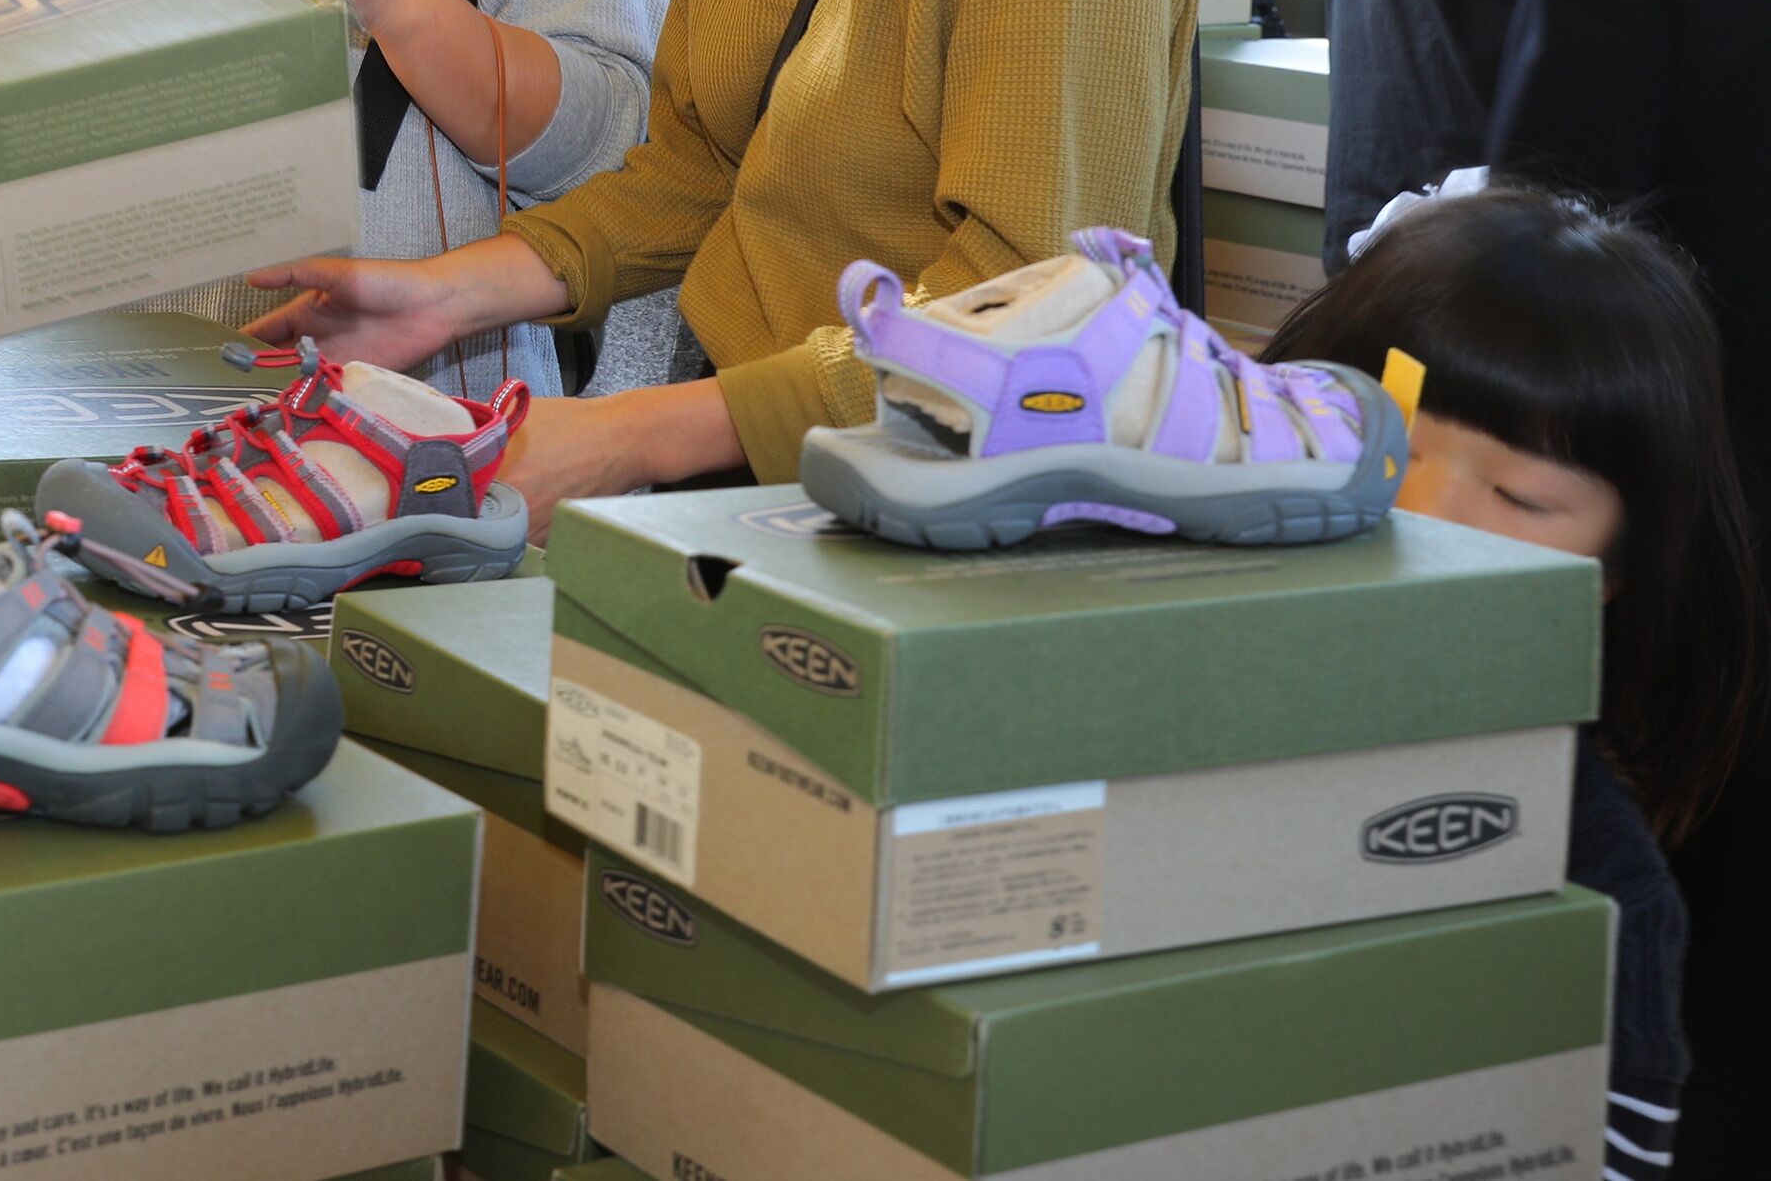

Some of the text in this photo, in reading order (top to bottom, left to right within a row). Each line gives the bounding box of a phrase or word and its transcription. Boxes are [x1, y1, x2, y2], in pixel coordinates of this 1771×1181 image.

[342, 634, 412, 687] KEEN
[762, 631, 857, 688] KEEN
[1369, 804, 1512, 854] KEEN
[603, 877, 694, 938] KEEN
[8, 1116, 42, 1138] and
[122, 1095, 152, 1116] way
[152, 1088, 171, 1107] of
[200, 1076, 224, 1096] We
[223, 1070, 252, 1092] call
